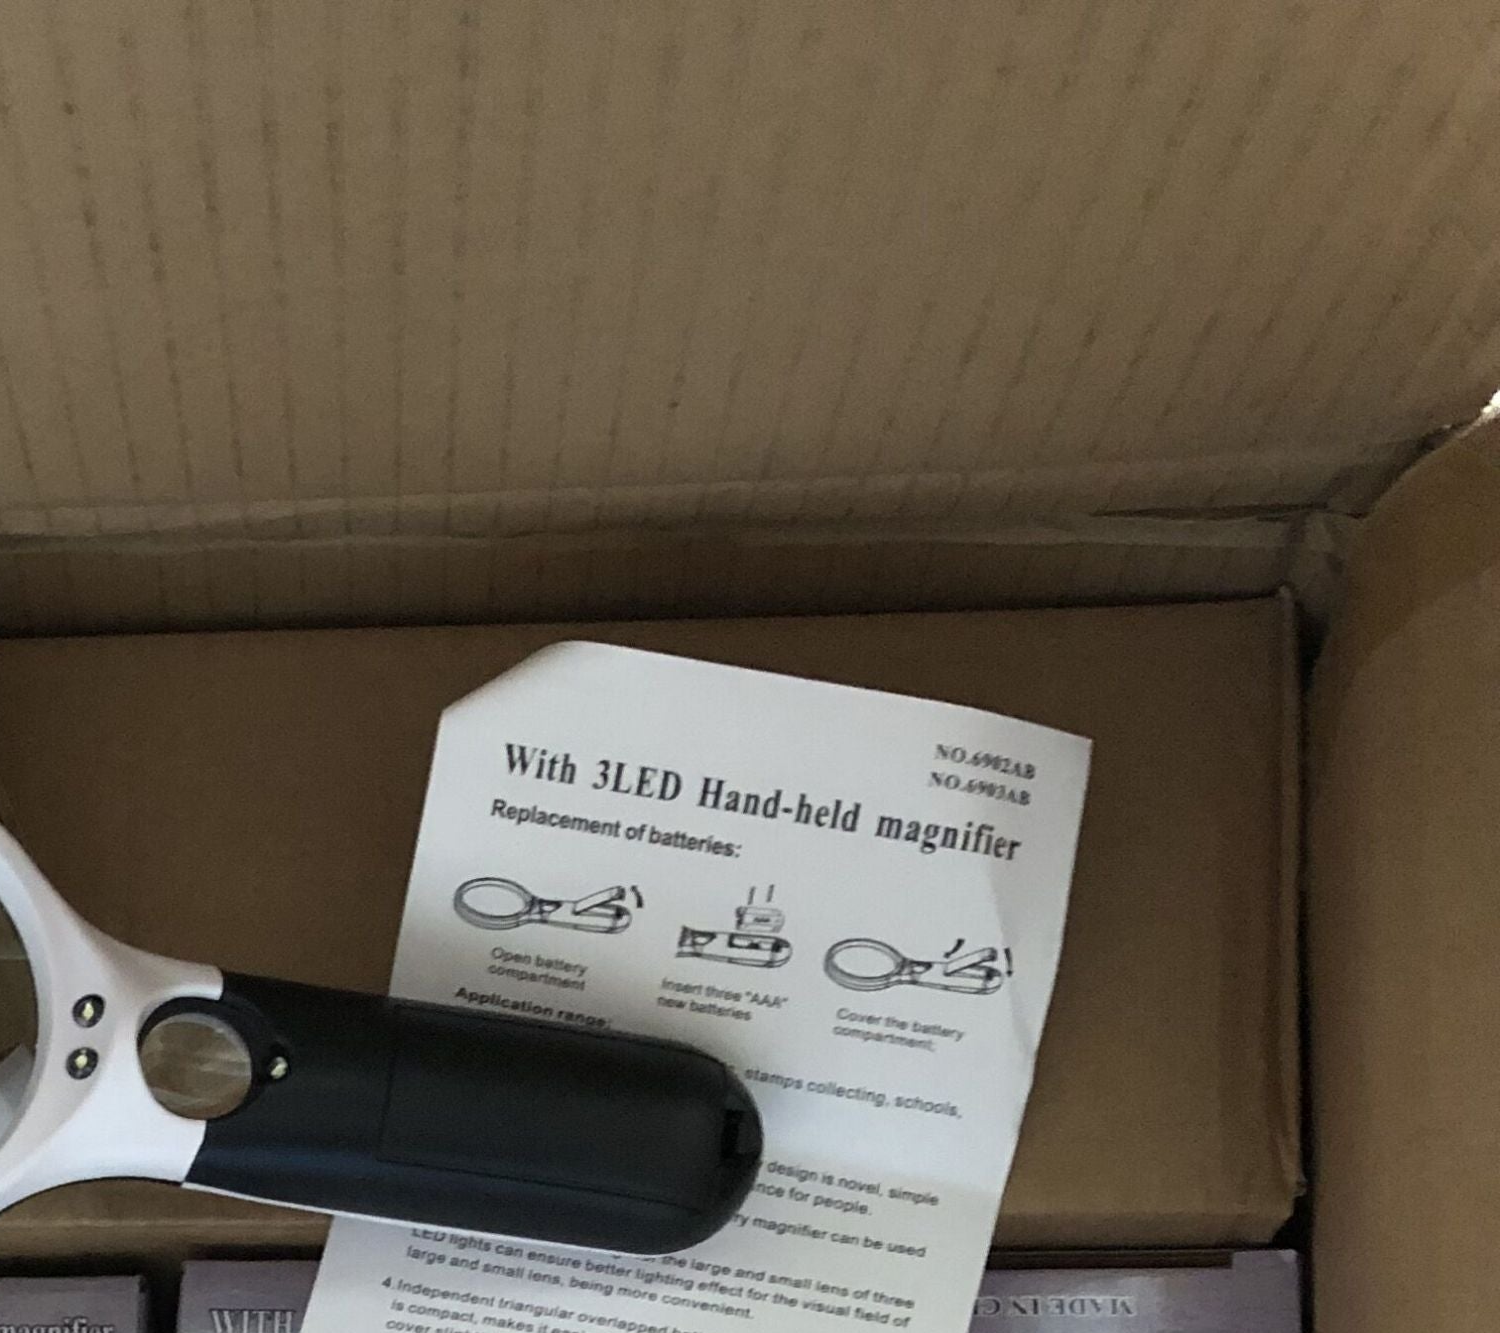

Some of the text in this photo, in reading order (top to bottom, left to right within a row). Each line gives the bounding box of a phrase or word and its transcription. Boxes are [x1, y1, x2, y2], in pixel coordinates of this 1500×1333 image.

[505, 743, 1022, 861] With 3LED Hand-held magnifier
[490, 799, 742, 860] Replacement of batteries:
[380, 1275, 495, 1309] 4.Independent
[497, 1296, 574, 1323] triangular
[390, 1298, 405, 1312] is
[407, 1301, 477, 1326] compact,
[481, 1314, 533, 1333] makes
[1012, 1298, 1041, 1317] IN
[1050, 1298, 1136, 1317] MADE
